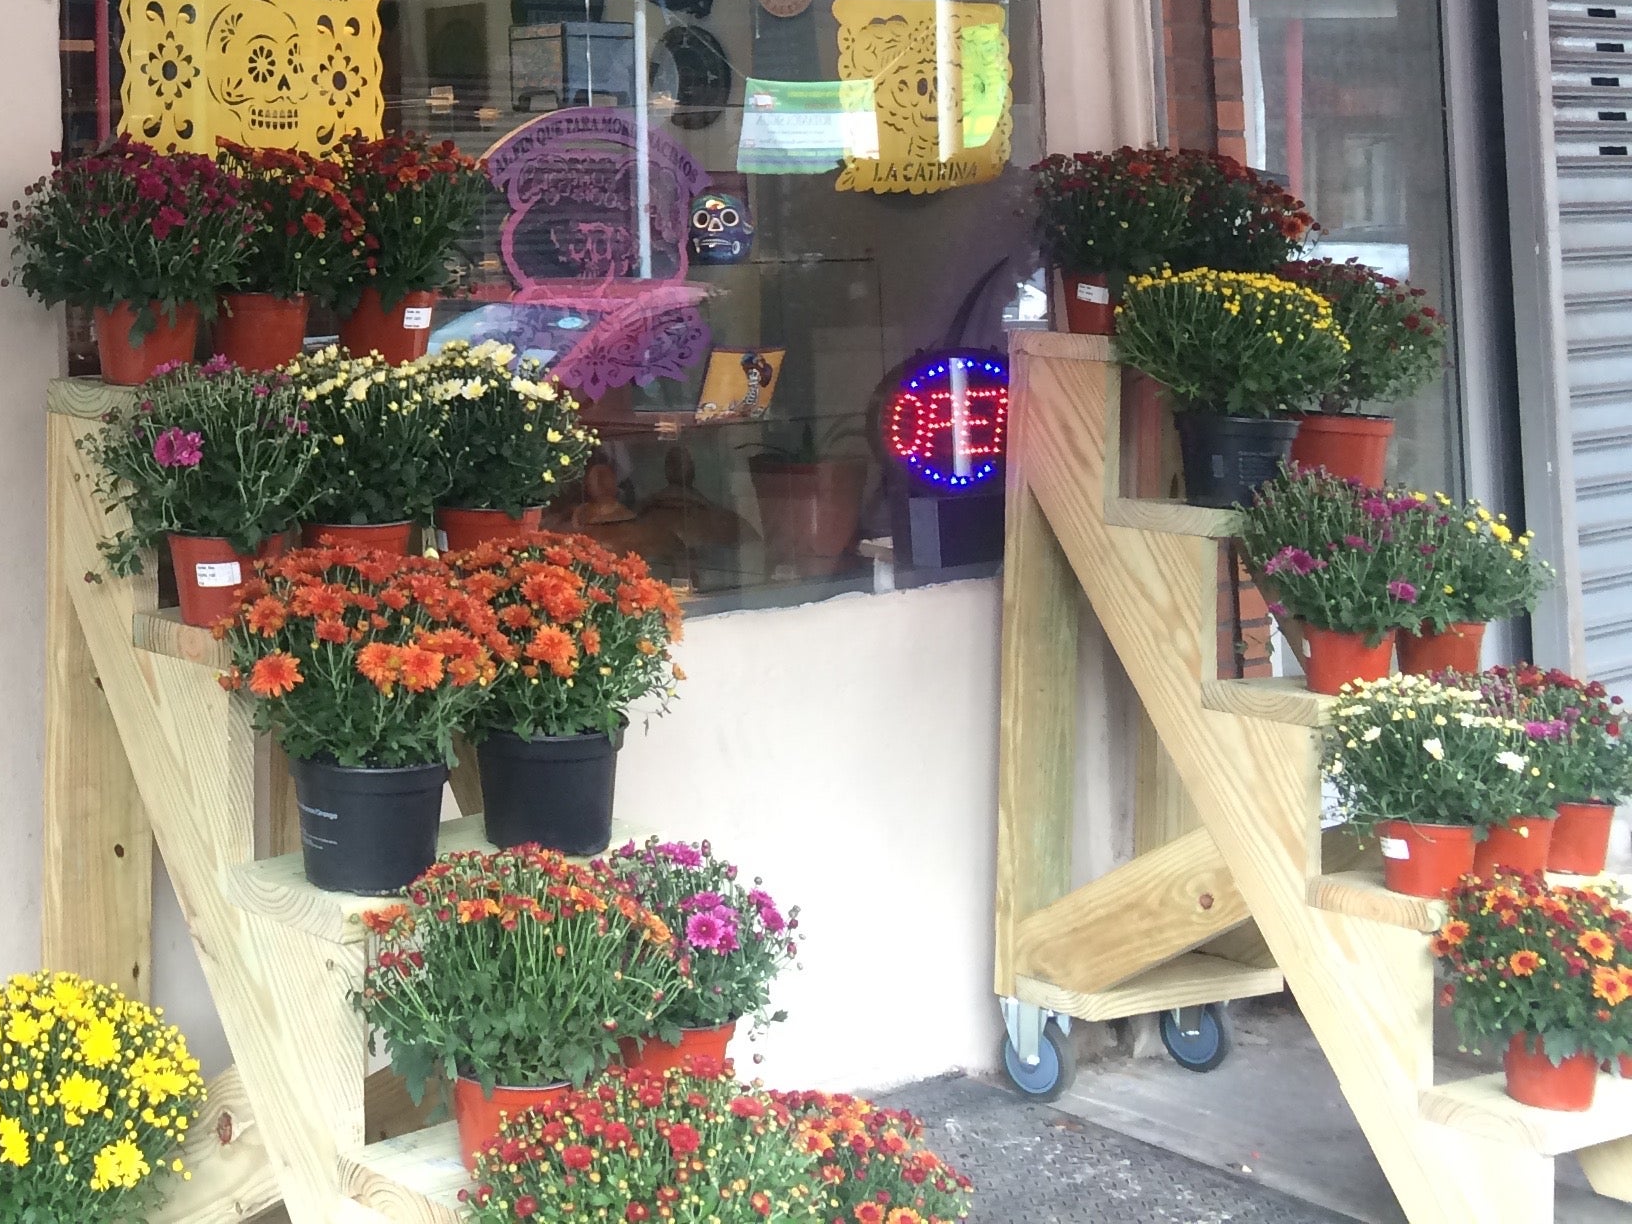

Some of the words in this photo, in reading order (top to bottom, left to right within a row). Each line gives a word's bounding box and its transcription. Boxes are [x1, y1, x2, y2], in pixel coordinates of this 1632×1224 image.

[536, 120, 565, 146] QUE
[872, 163, 898, 183] LA
[902, 161, 978, 183] CATRINA
